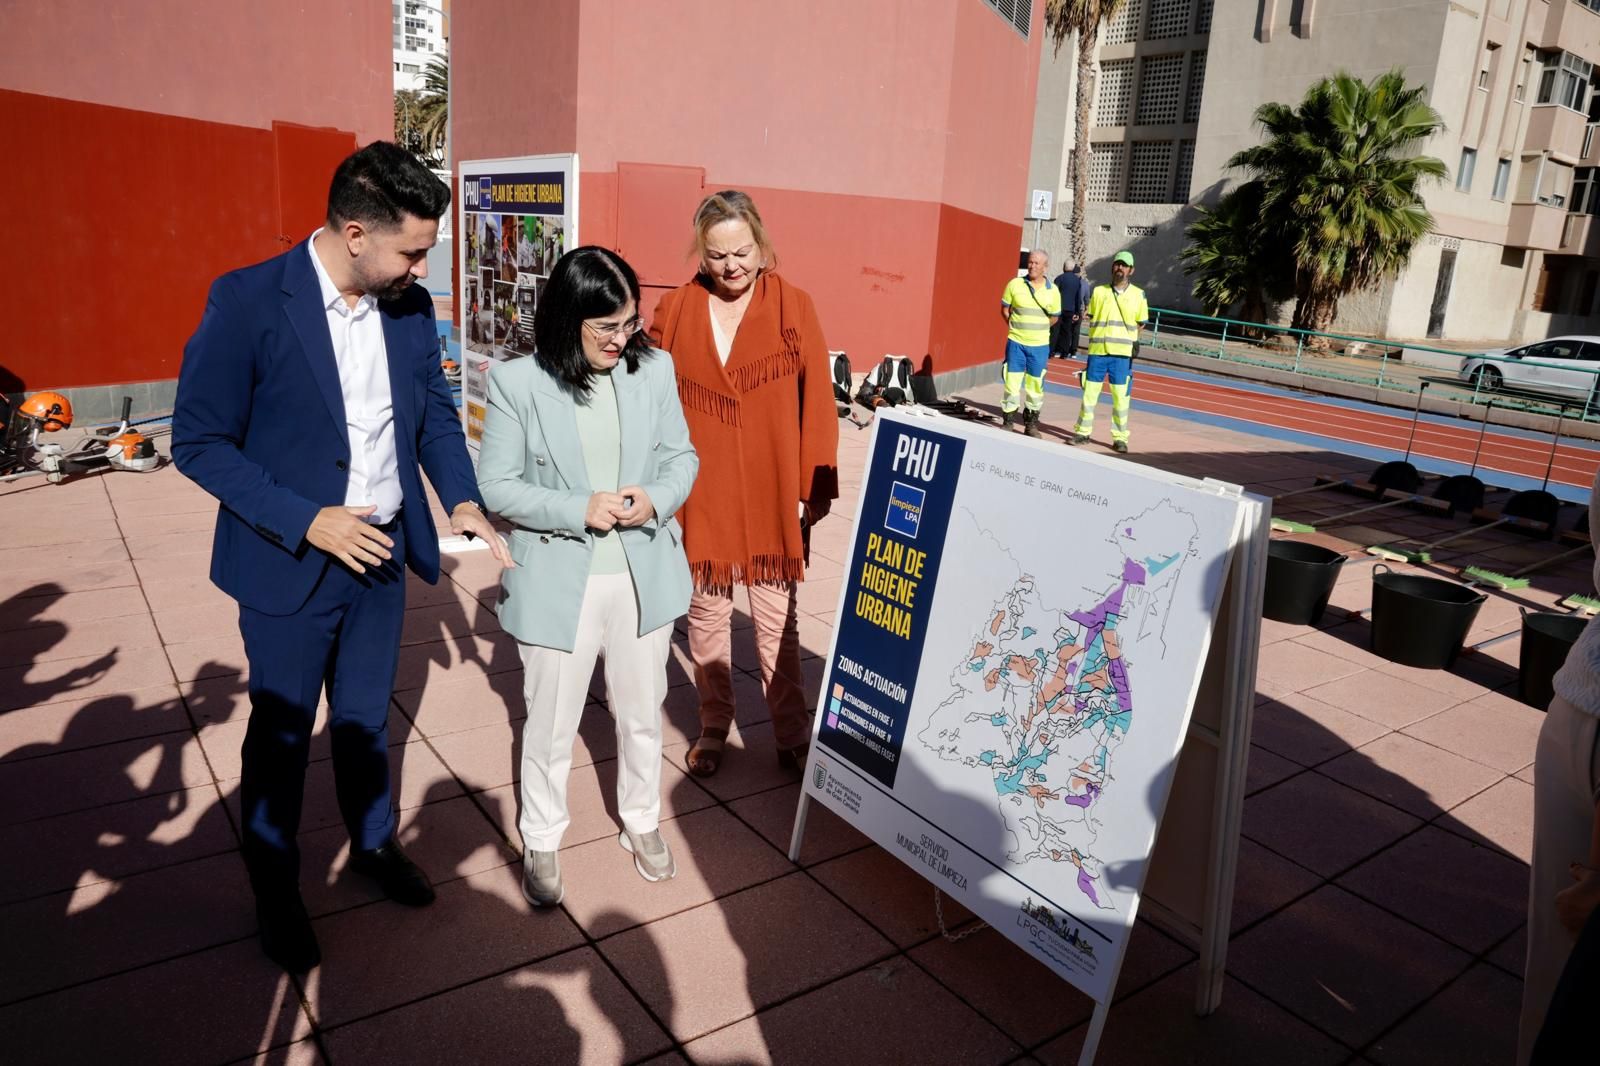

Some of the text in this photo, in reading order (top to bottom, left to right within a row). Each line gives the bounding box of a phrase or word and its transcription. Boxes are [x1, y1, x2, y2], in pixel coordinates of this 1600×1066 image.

[465, 181, 479, 206] PHU
[492, 184, 563, 203] PLAN DE HIGIENE URBANA
[892, 433, 940, 482] PHU
[970, 460, 1109, 508] LAS PALMAS DE GRAN CANARIA
[890, 496, 920, 514] limpieza
[904, 511, 918, 523] LPA
[866, 532, 927, 579] PLAN DE
[860, 561, 918, 608] HIGIENE
[855, 591, 912, 641] URBANA
[838, 655, 907, 704] ZONAS ACTUACIÓN
[840, 706, 869, 729] ACTUACIONES
[868, 720, 876, 733] EN
[875, 725, 887, 741] FASE
[843, 691, 872, 714] ACTUACIONES
[871, 705, 879, 718] EN
[878, 710, 891, 726] FASE
[837, 721, 866, 745] ACTUACIONES
[880, 747, 896, 763] FASES
[828, 774, 862, 801] Ayuntamiento
[831, 791, 842, 802] Gran
[834, 786, 842, 795] Las
[843, 792, 861, 808] Palmas
[895, 832, 968, 892] MUNICIPAL DE LIMPIEZA
[920, 834, 949, 861] SERVICIO
[1016, 914, 1047, 942] LPGC
